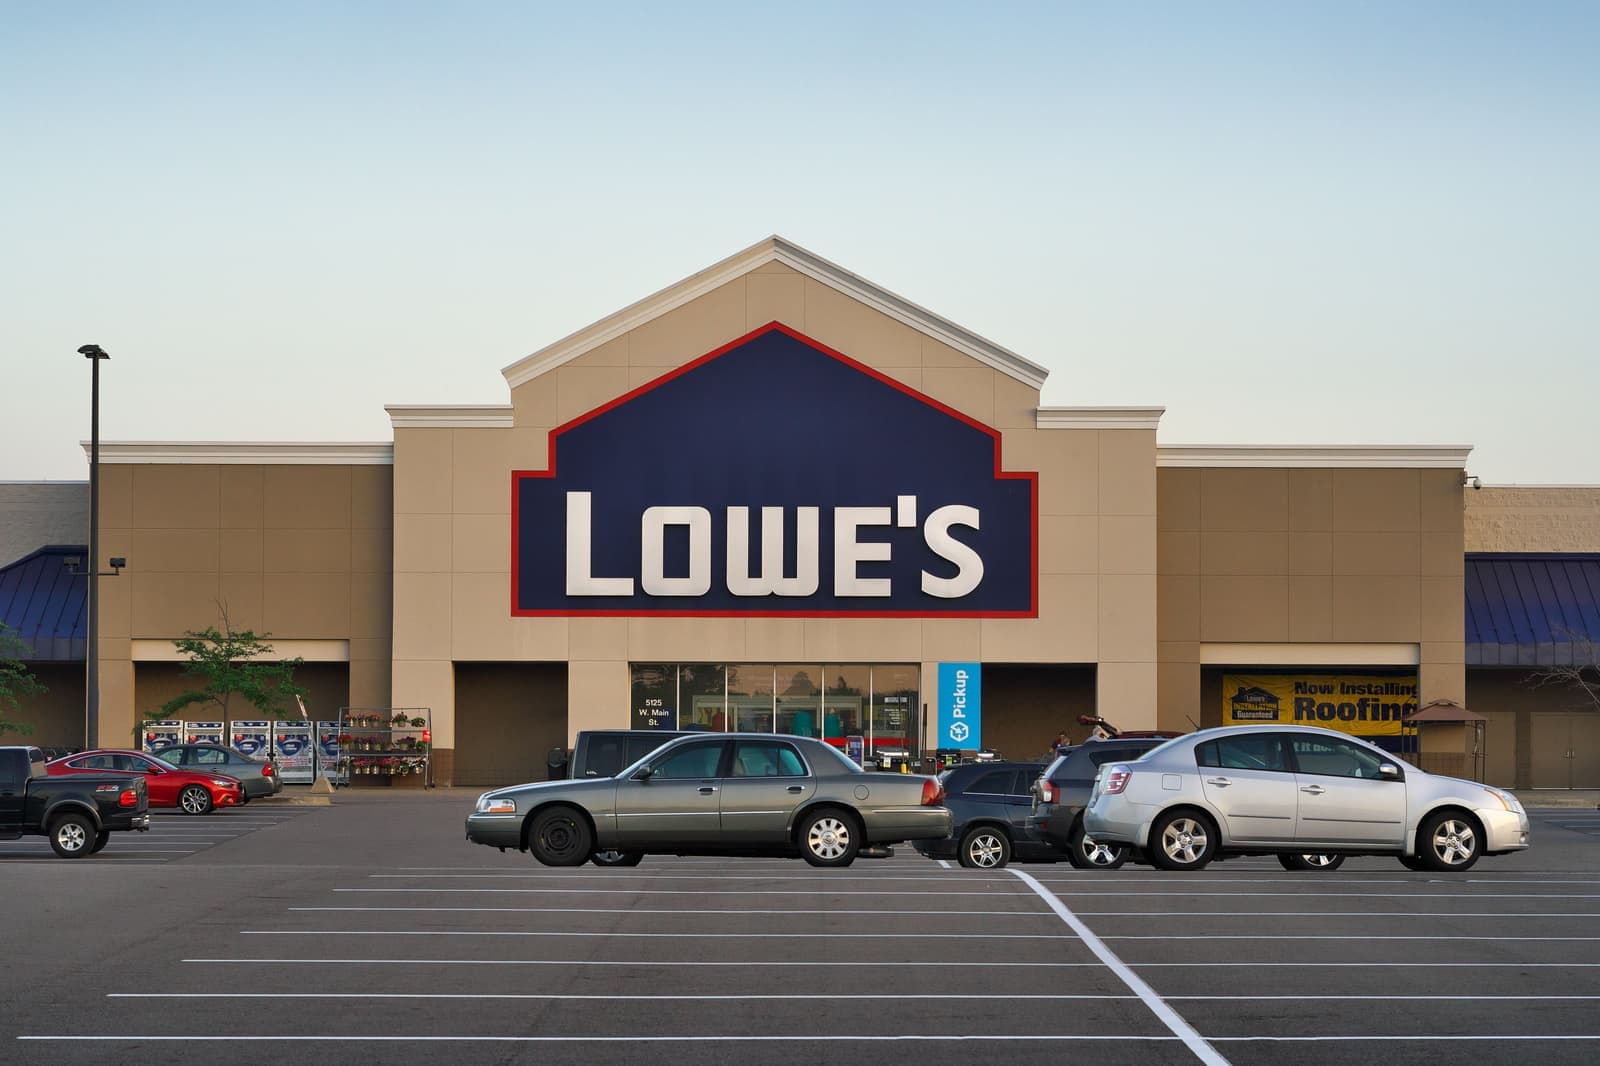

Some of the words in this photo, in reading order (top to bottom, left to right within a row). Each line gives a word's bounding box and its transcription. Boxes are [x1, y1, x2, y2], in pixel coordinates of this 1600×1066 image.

[566, 491, 985, 599] LOWE'S
[1294, 681, 1334, 695] Now
[952, 669, 969, 719] Pickup
[645, 698, 663, 707] 5125
[638, 708, 650, 717] W.
[651, 708, 670, 717] Main
[1237, 710, 1273, 719] Guaranteed
[648, 718, 660, 727] St.
